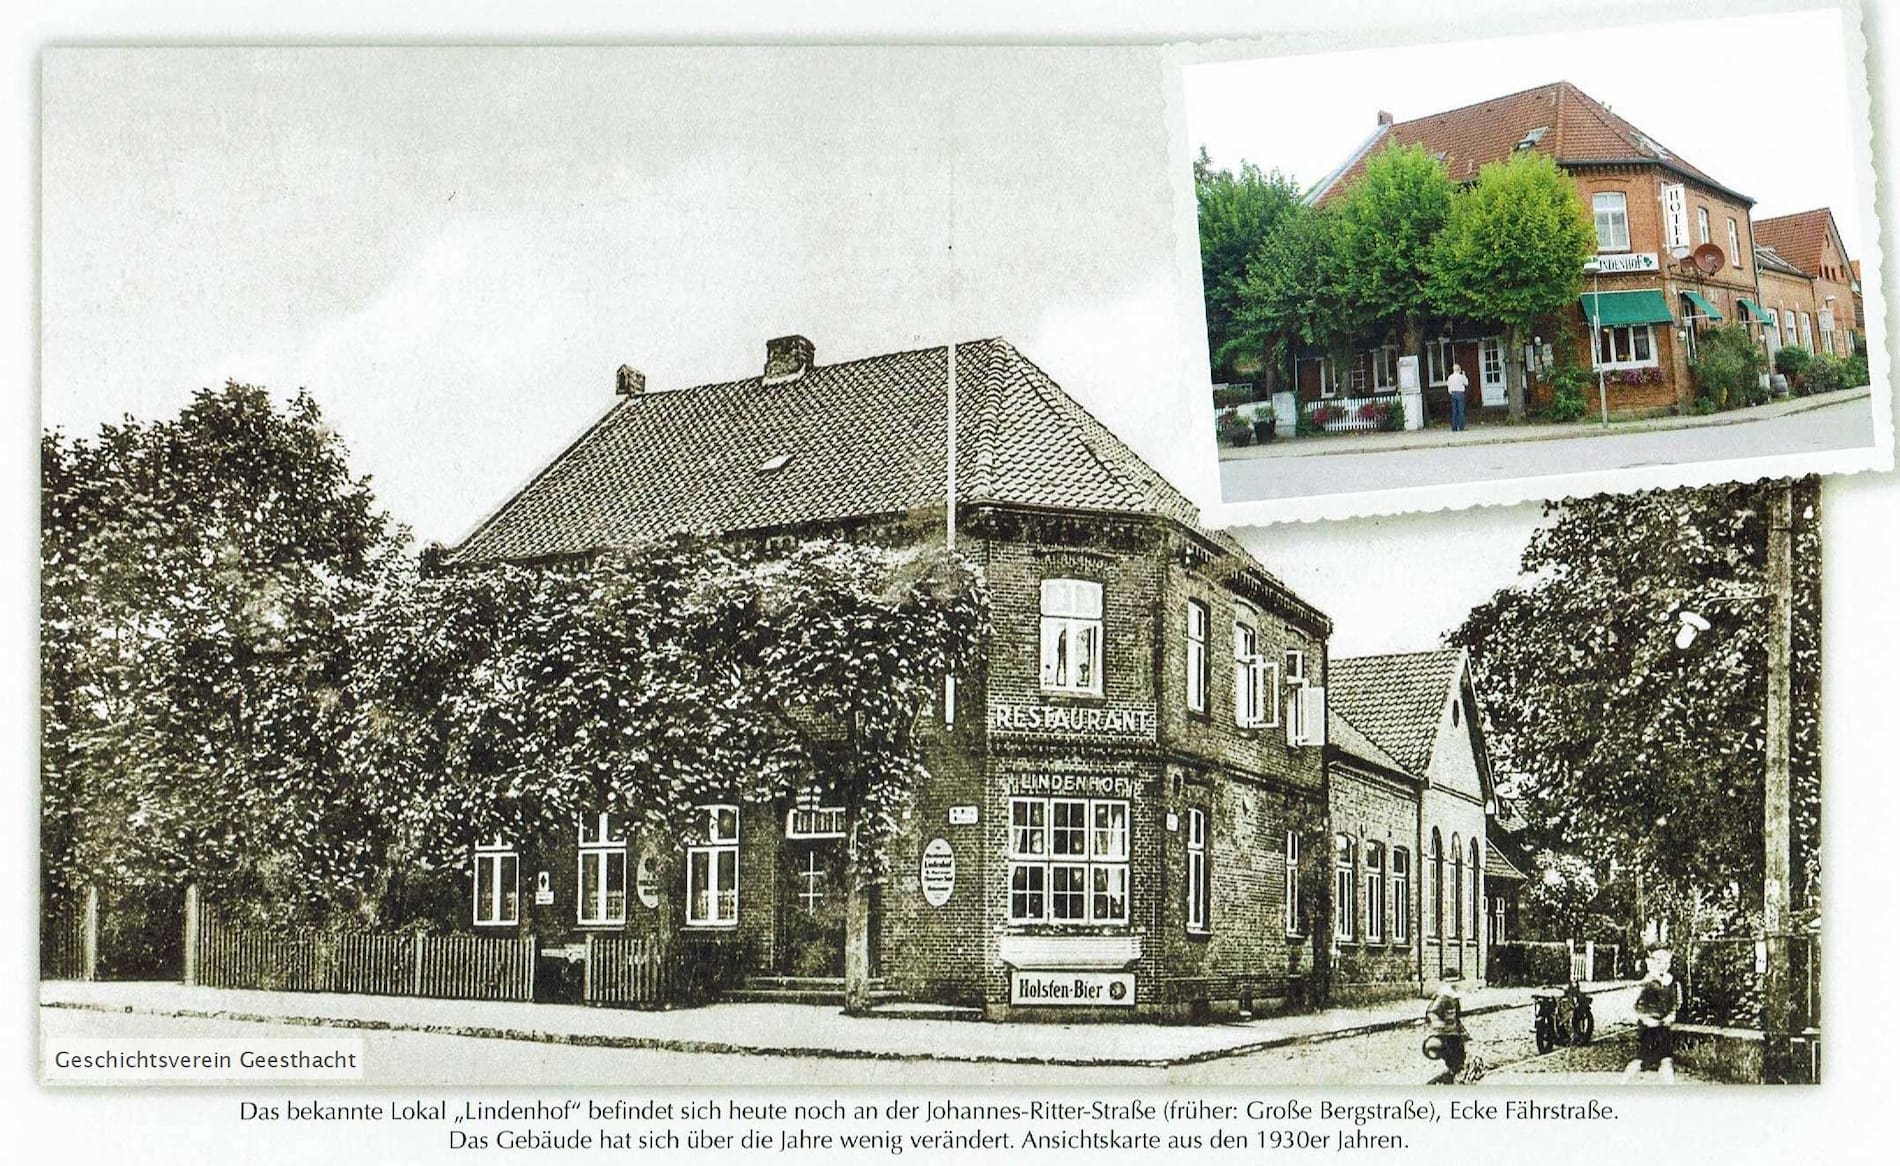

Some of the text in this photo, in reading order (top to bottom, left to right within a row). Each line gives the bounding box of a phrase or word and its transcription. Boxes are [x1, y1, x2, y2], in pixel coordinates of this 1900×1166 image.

[1669, 189, 1681, 245] HOTEL
[1598, 254, 1643, 271] INDENHOF
[996, 704, 1149, 733] RESTAURANT
[1021, 773, 1123, 793] LINDENHOF
[1018, 978, 1103, 999] Holsten-Bier
